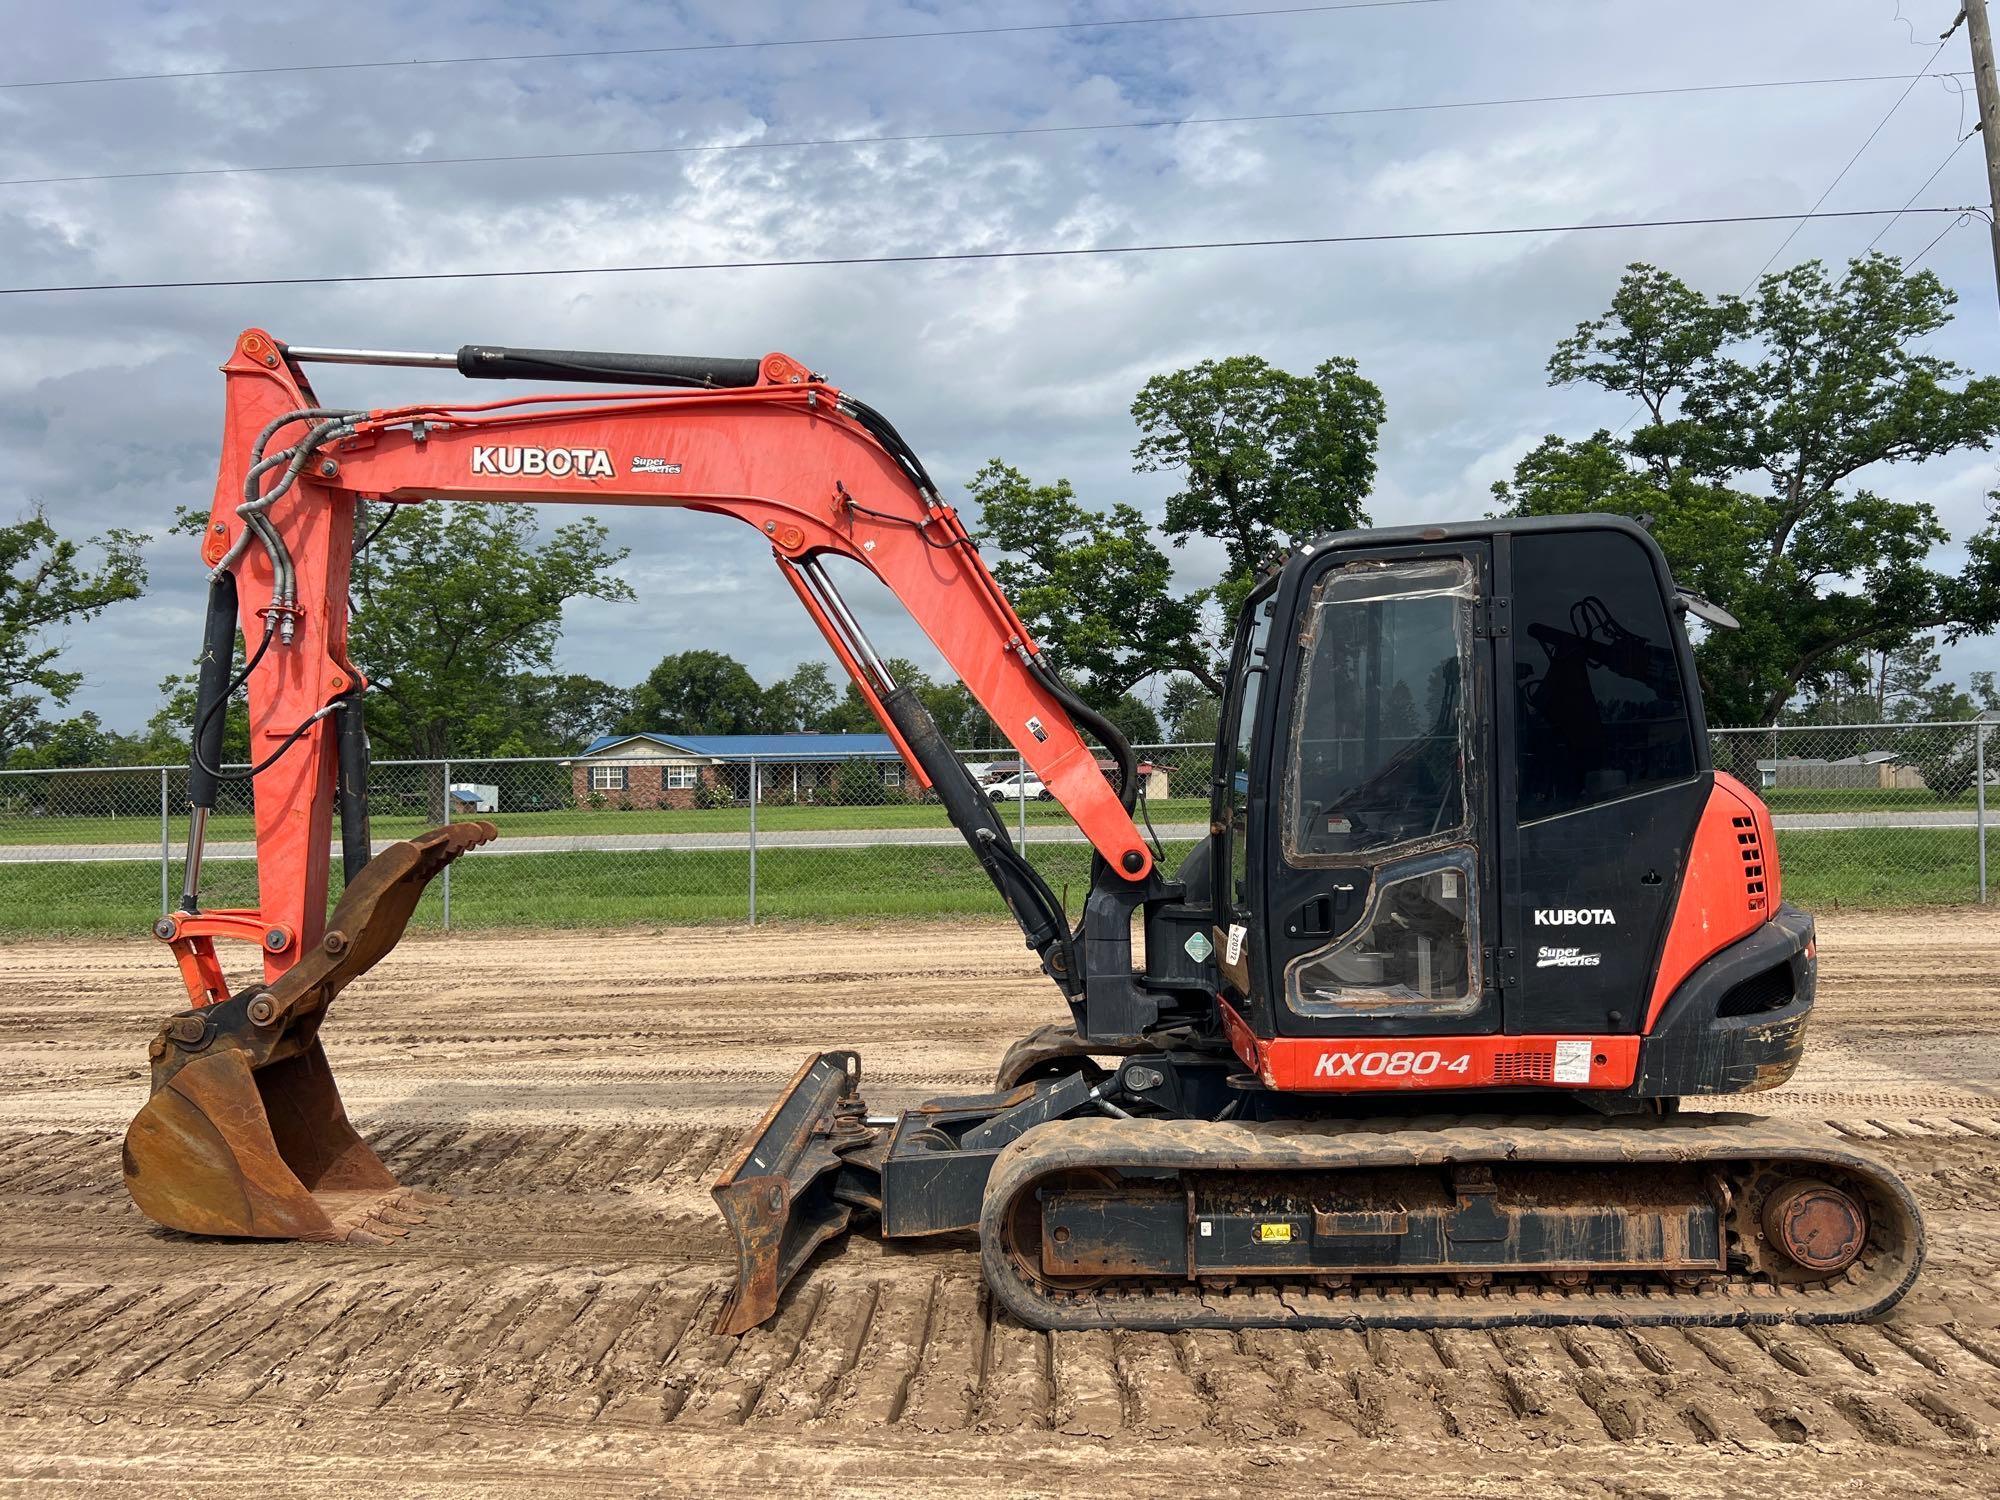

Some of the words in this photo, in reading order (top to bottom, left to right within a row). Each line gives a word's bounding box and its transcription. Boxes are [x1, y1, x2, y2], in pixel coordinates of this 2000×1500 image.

[472, 446, 615, 477] KUBOTA
[632, 456, 665, 467] Super
[647, 464, 681, 474] Series
[1534, 908, 1616, 926] KUBOTA
[1538, 946, 1580, 960] Super
[1558, 955, 1600, 967] Series
[1313, 1051, 1471, 1077] KX080-4
